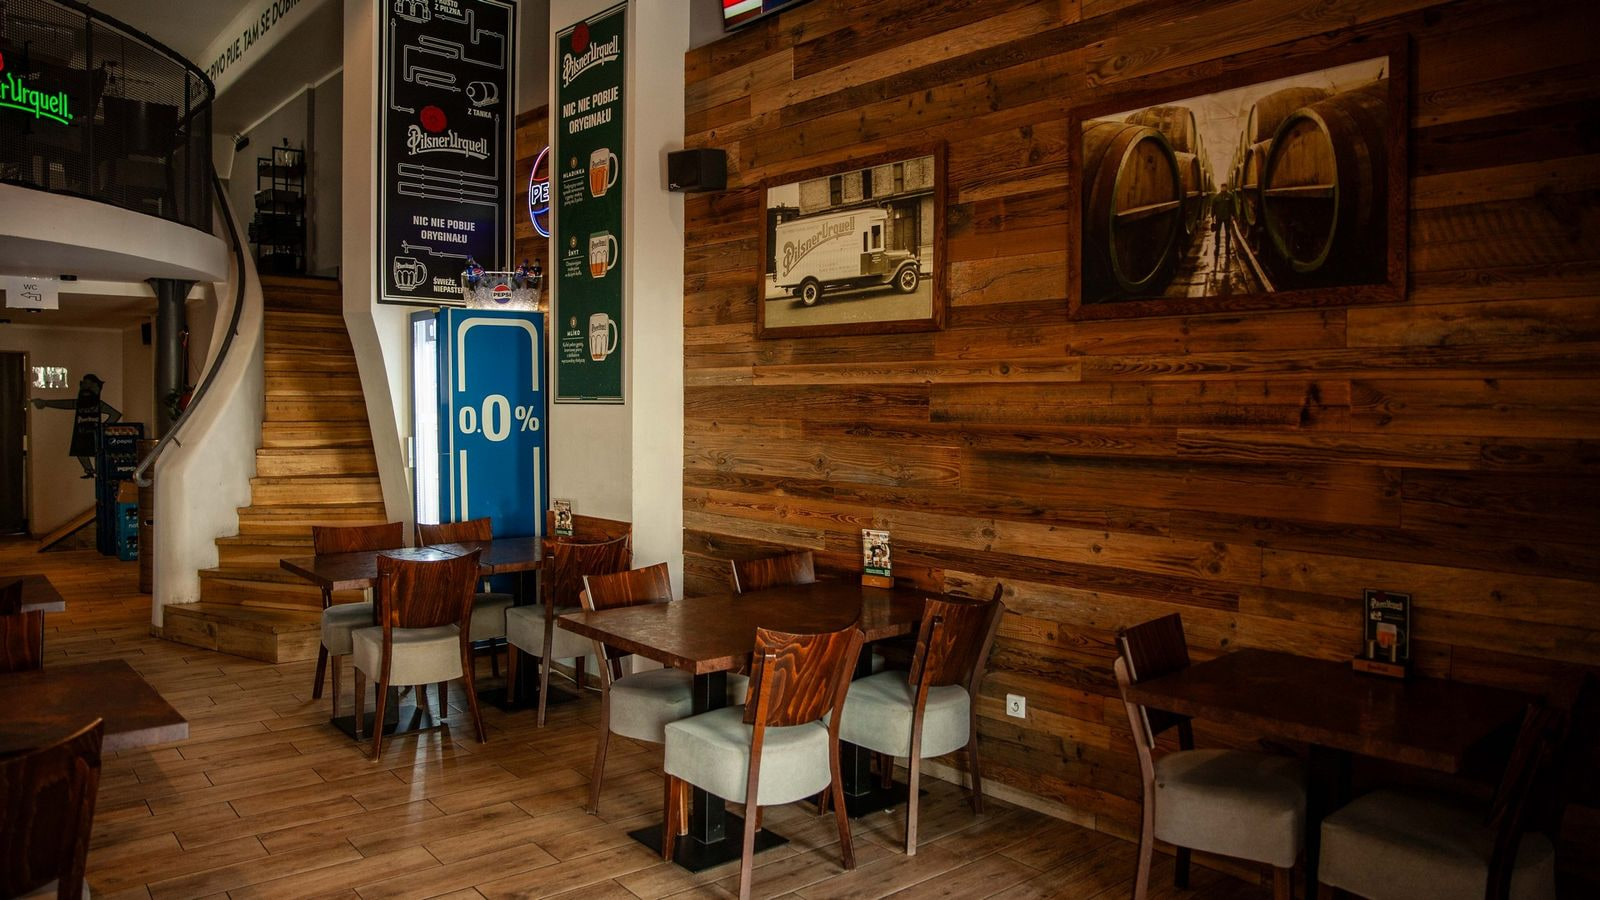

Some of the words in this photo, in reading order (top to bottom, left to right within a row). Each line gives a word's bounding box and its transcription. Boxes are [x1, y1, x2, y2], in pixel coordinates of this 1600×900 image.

[243, 21, 259, 52] TAM
[261, 8, 270, 36] SE
[563, 52, 591, 88] Pilsner
[474, 109, 492, 119] TANKA
[563, 102, 576, 118] NIC
[578, 96, 590, 113] NIE
[592, 86, 619, 108] POBIJE
[569, 108, 611, 134] ORYGINAŁU
[407, 124, 451, 156] Pilsner
[413, 216, 428, 226] NIC
[431, 218, 445, 228] NIE
[448, 219, 475, 232] POBIJE
[421, 230, 468, 244] ORYGINAŁU
[783, 232, 822, 277] Pilsner
